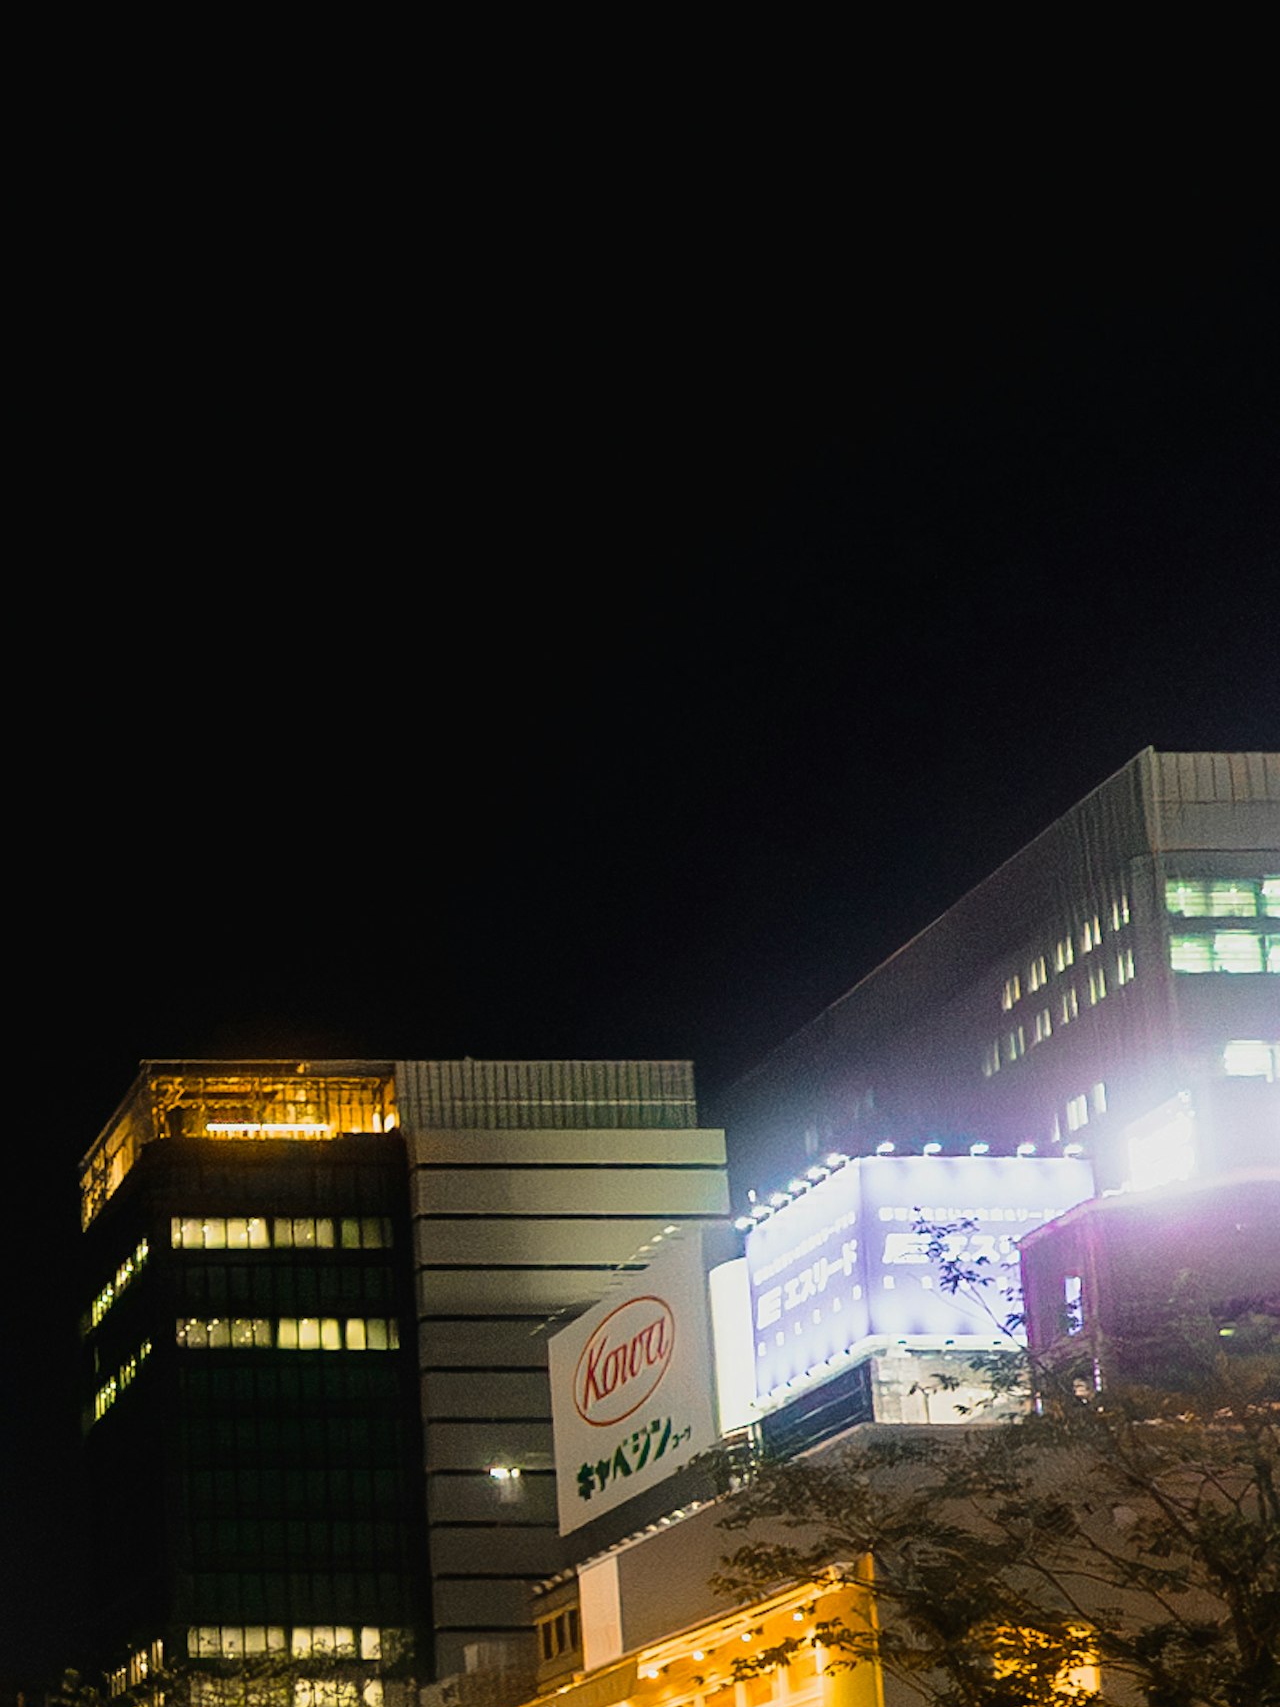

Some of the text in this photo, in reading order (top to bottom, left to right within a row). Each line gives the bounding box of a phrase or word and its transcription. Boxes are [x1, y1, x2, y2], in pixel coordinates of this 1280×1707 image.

[584, 1315, 670, 1411] Kowa
[576, 1415, 672, 1501] キャベジン
